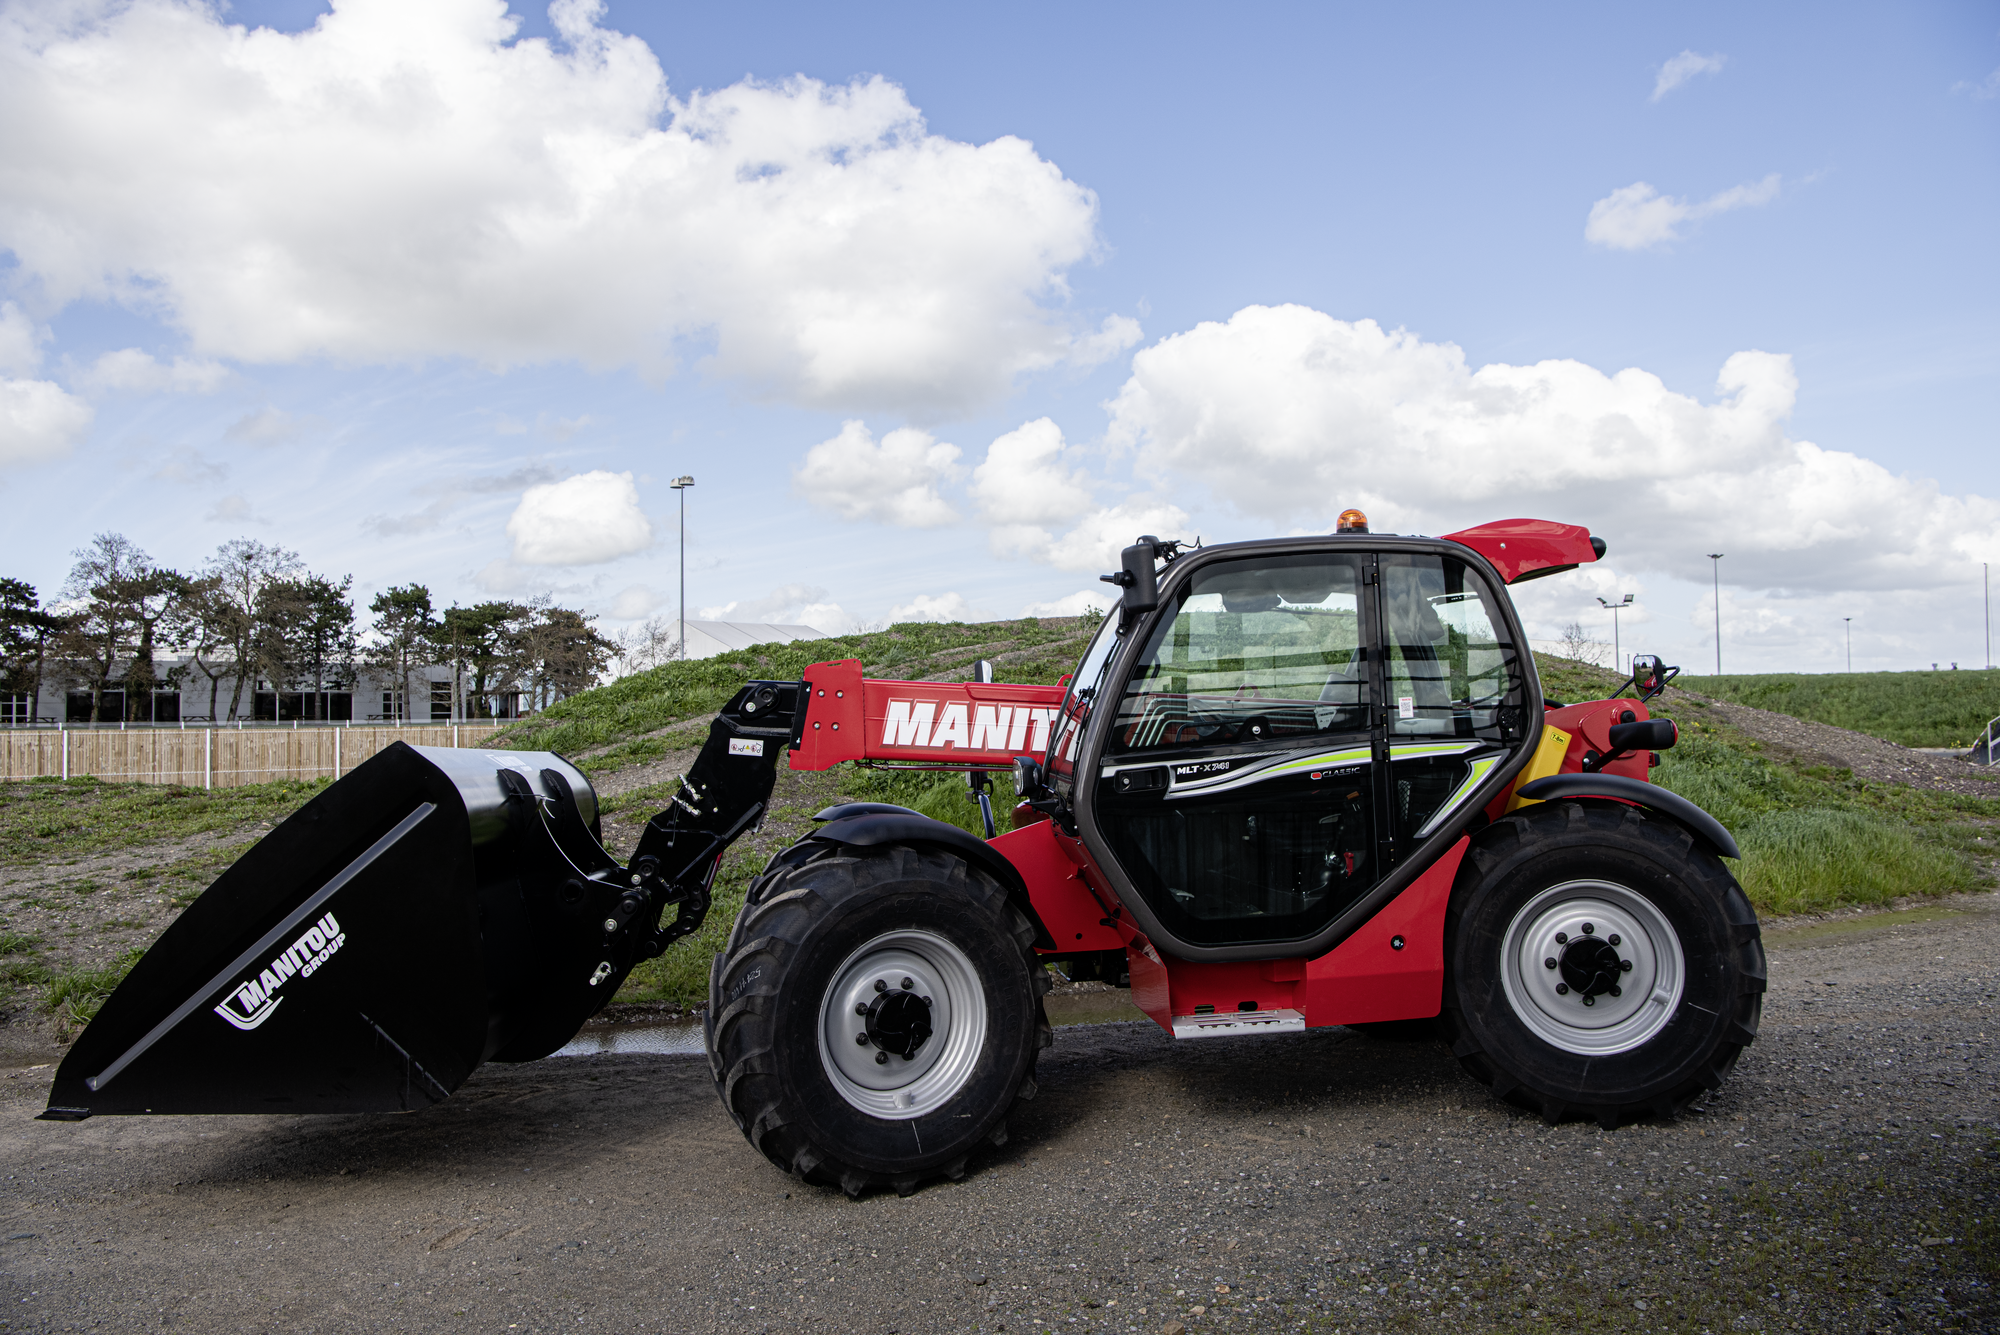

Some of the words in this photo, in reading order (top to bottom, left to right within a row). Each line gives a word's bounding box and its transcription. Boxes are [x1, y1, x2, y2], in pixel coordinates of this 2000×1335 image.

[1322, 767, 1361, 778] CLASSIC
[237, 911, 340, 1014] MANITOU
[300, 933, 346, 978] GROUP
